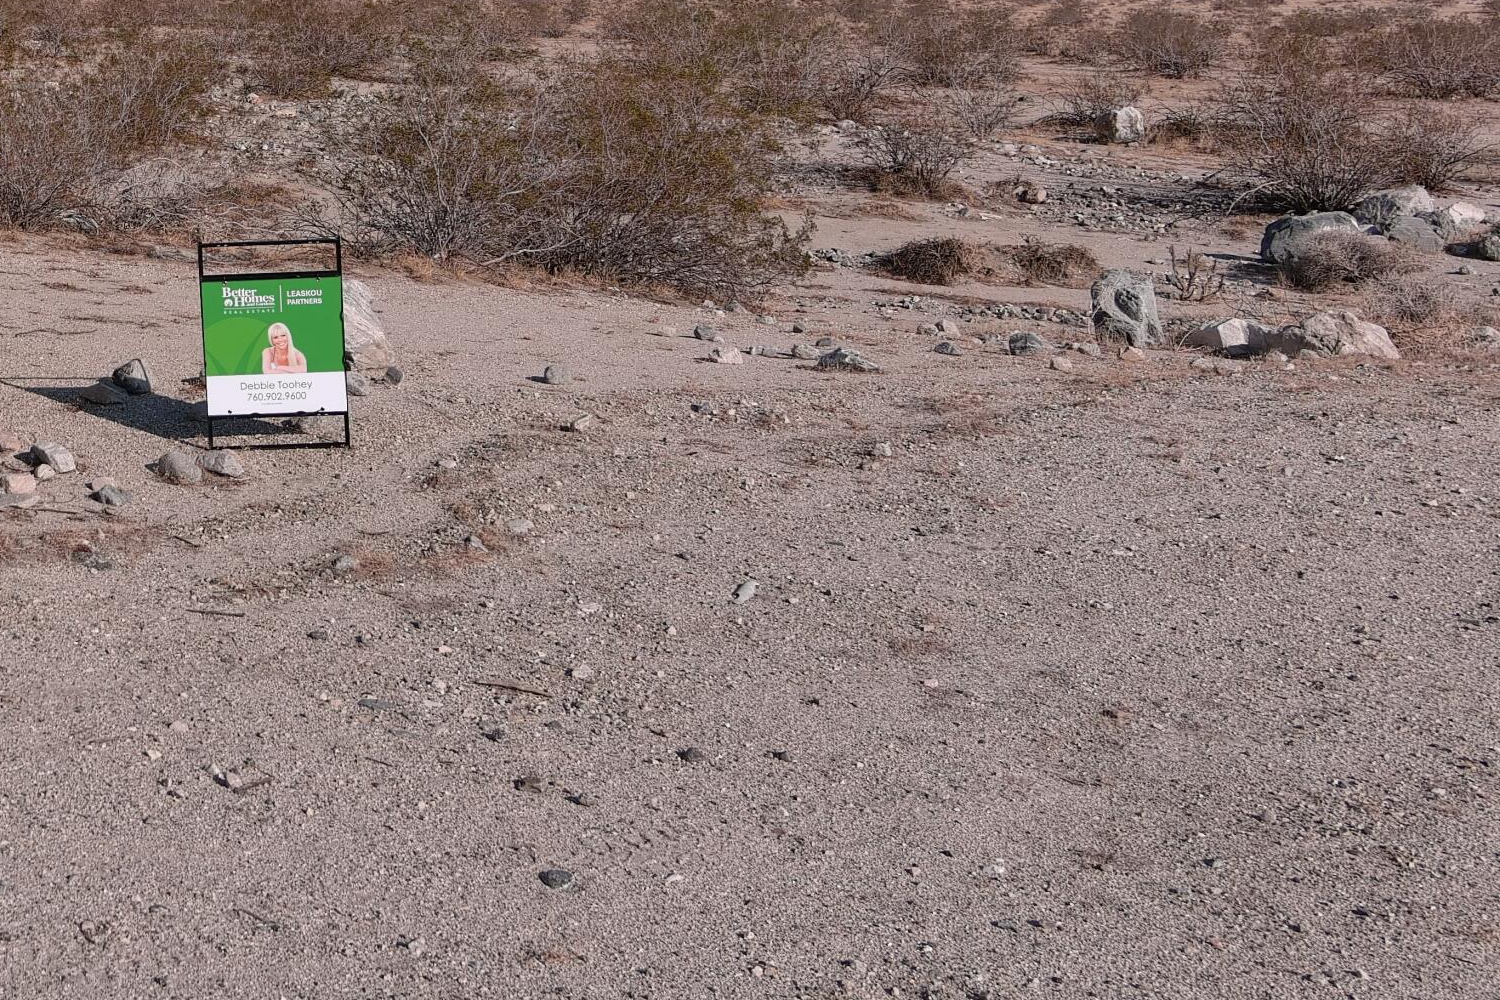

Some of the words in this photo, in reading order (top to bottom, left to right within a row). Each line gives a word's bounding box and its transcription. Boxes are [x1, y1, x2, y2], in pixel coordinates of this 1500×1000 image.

[221, 287, 257, 298] Better
[286, 289, 323, 297] LEASKOU
[234, 294, 275, 307] Homes
[286, 297, 323, 305] PARTNERS
[240, 381, 275, 391] Debbie
[278, 380, 313, 390] Toohey
[247, 391, 307, 402] 760.902.9600
